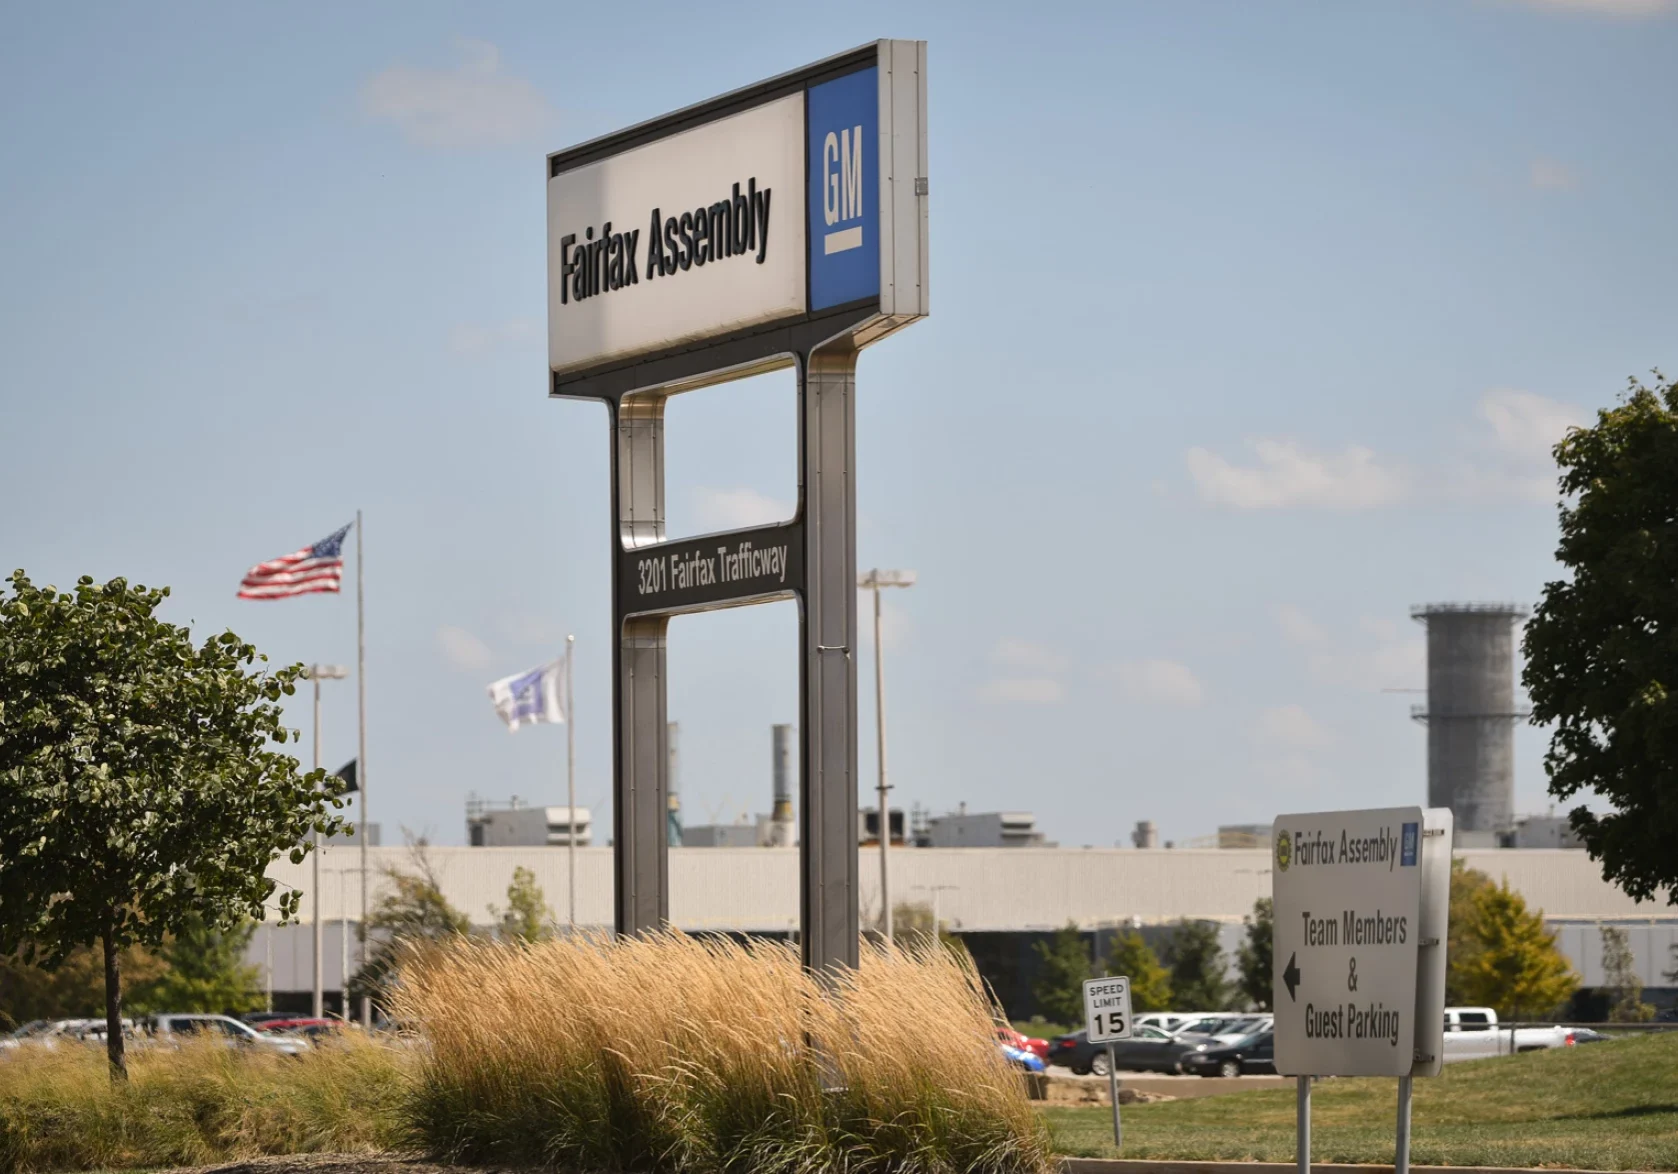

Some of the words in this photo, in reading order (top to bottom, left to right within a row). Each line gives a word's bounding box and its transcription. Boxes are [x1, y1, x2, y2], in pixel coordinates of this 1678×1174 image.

[823, 125, 862, 226] GM
[560, 222, 639, 305] Fairfax
[646, 177, 772, 280] Assembly
[638, 556, 667, 595] 3201
[671, 550, 716, 590] Fairfax
[717, 541, 788, 583] Trafficway
[1294, 830, 1335, 866] Fairfax
[1338, 826, 1398, 872] Assembly
[1302, 911, 1338, 946] Team
[1343, 909, 1407, 945] Members
[1090, 984, 1125, 996] SPEED
[1347, 956, 1358, 992] &
[1093, 996, 1122, 1008] LIMIT
[1094, 1011, 1125, 1035] 15
[1305, 1002, 1343, 1039] Guest
[1347, 1002, 1399, 1047] Parking
